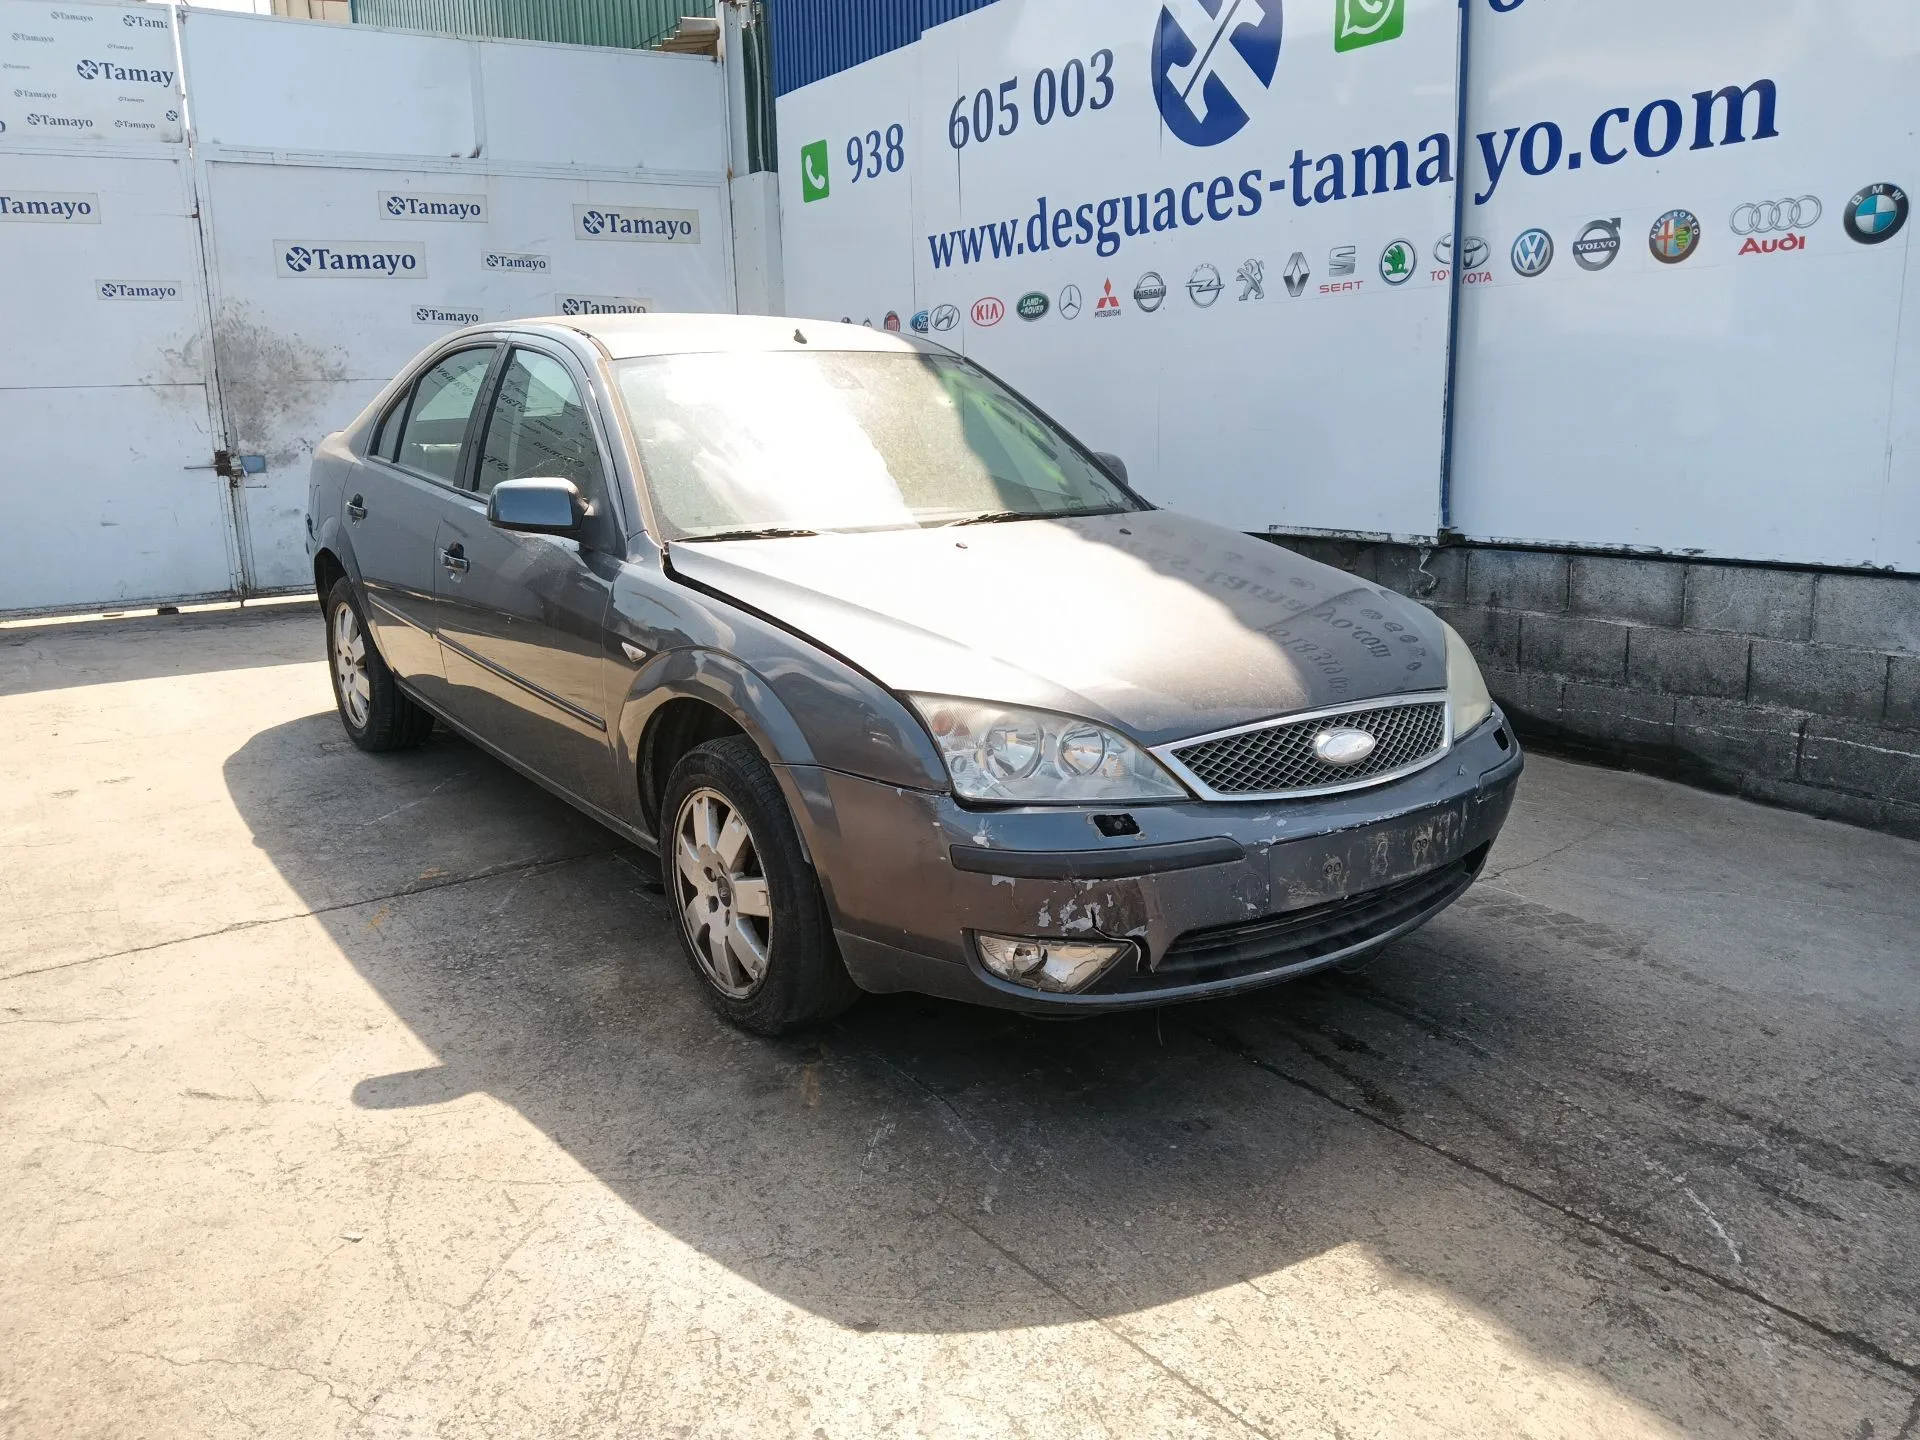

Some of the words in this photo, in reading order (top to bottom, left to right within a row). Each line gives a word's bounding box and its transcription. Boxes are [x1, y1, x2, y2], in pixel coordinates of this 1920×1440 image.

[60, 12, 93, 22] Tamayo
[20, 33, 54, 43] Tamayo
[23, 90, 57, 100] Tamayo
[40, 115, 93, 130] Tamayo
[847, 124, 905, 183] 938
[948, 77, 1019, 151] 605
[1033, 48, 1115, 125] 003
[122, 121, 155, 130] Tamayo
[404, 197, 481, 220] Tamayo
[605, 214, 692, 241] Tamayo
[1673, 211, 1699, 236] ROMEO
[1576, 240, 1617, 251] VOLVO
[1738, 234, 1806, 255] Audi
[312, 249, 417, 276] Tamayo
[498, 256, 547, 271] Tamayo
[117, 285, 176, 299] Tamayo
[1136, 287, 1164, 298] NISSAN
[1319, 280, 1364, 294] SEAT
[1022, 297, 1039, 307] LAND
[976, 303, 999, 321] KIA
[1023, 305, 1044, 314] ROVER
[1095, 309, 1122, 318] MITSUBISHI
[428, 310, 479, 324] Tamayo
